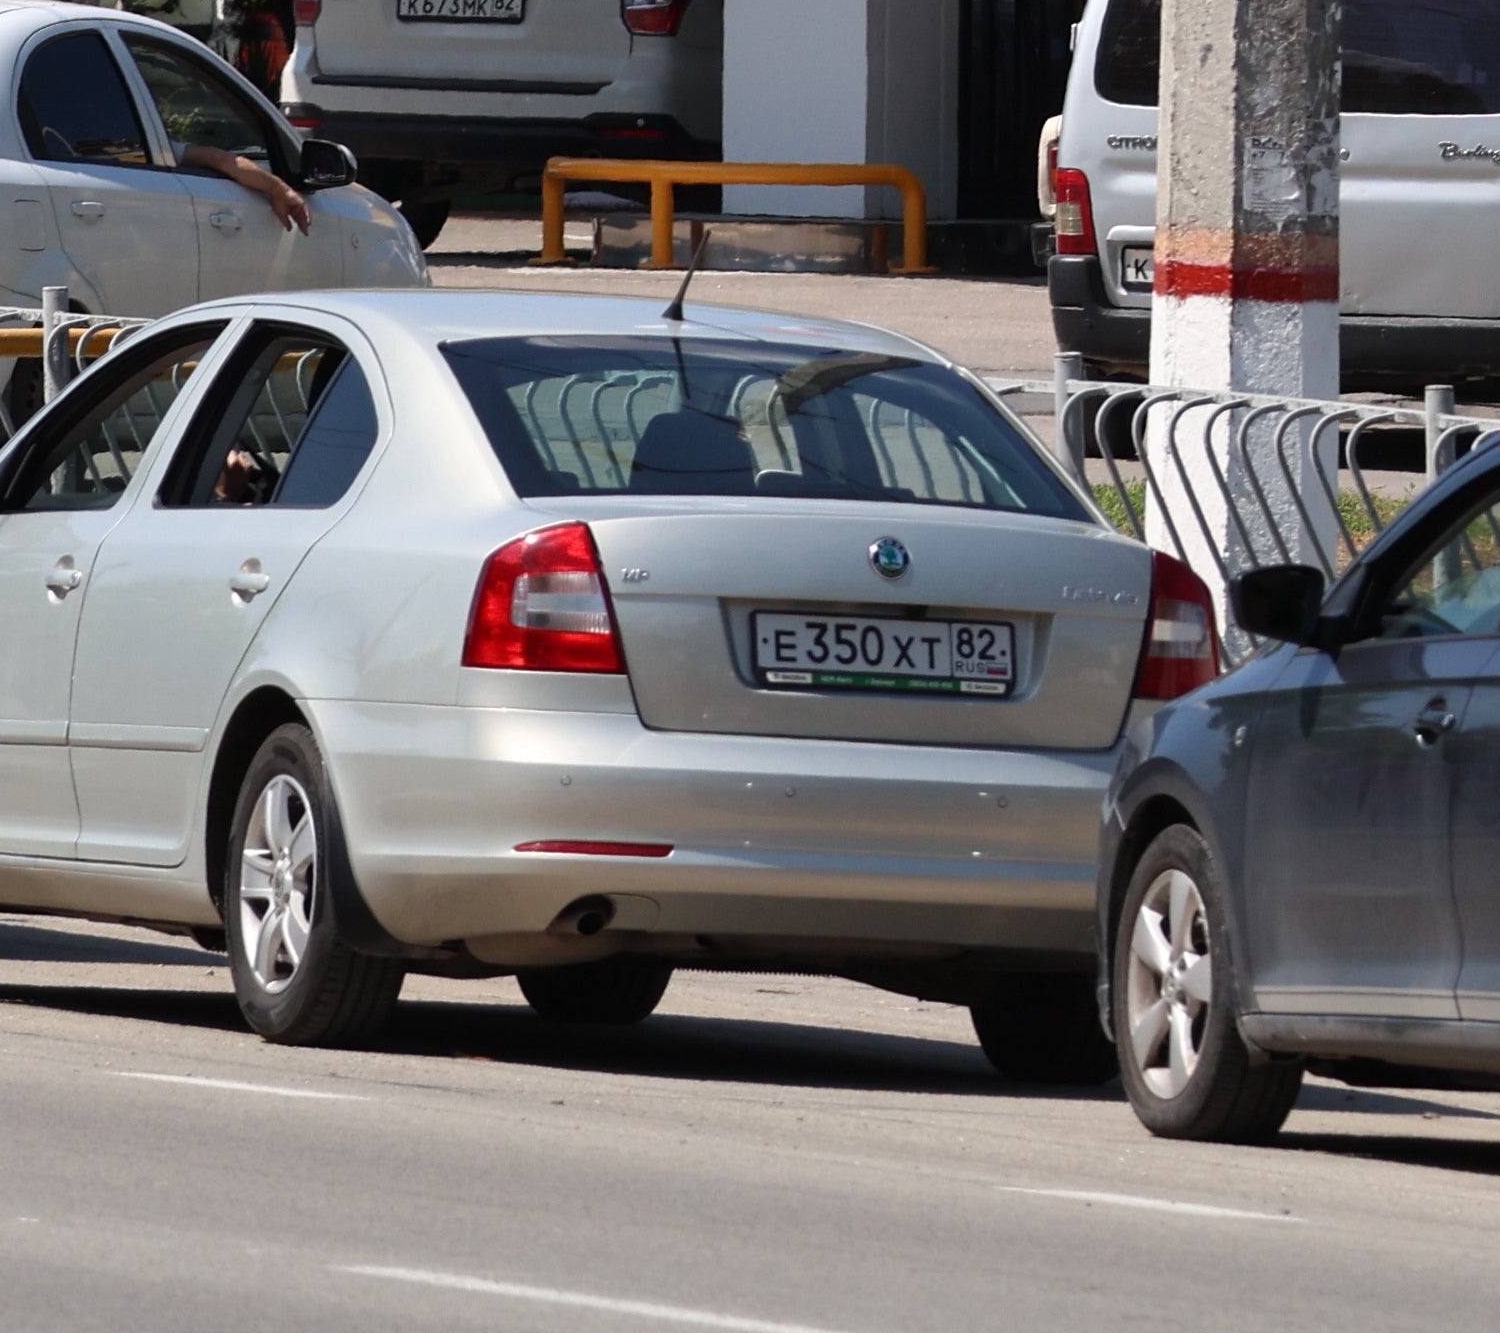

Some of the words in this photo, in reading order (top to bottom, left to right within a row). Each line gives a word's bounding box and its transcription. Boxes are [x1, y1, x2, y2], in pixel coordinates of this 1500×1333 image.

[774, 621, 942, 670] Е350ХТ
[956, 627, 996, 661] 82
[955, 661, 985, 673] RUS
